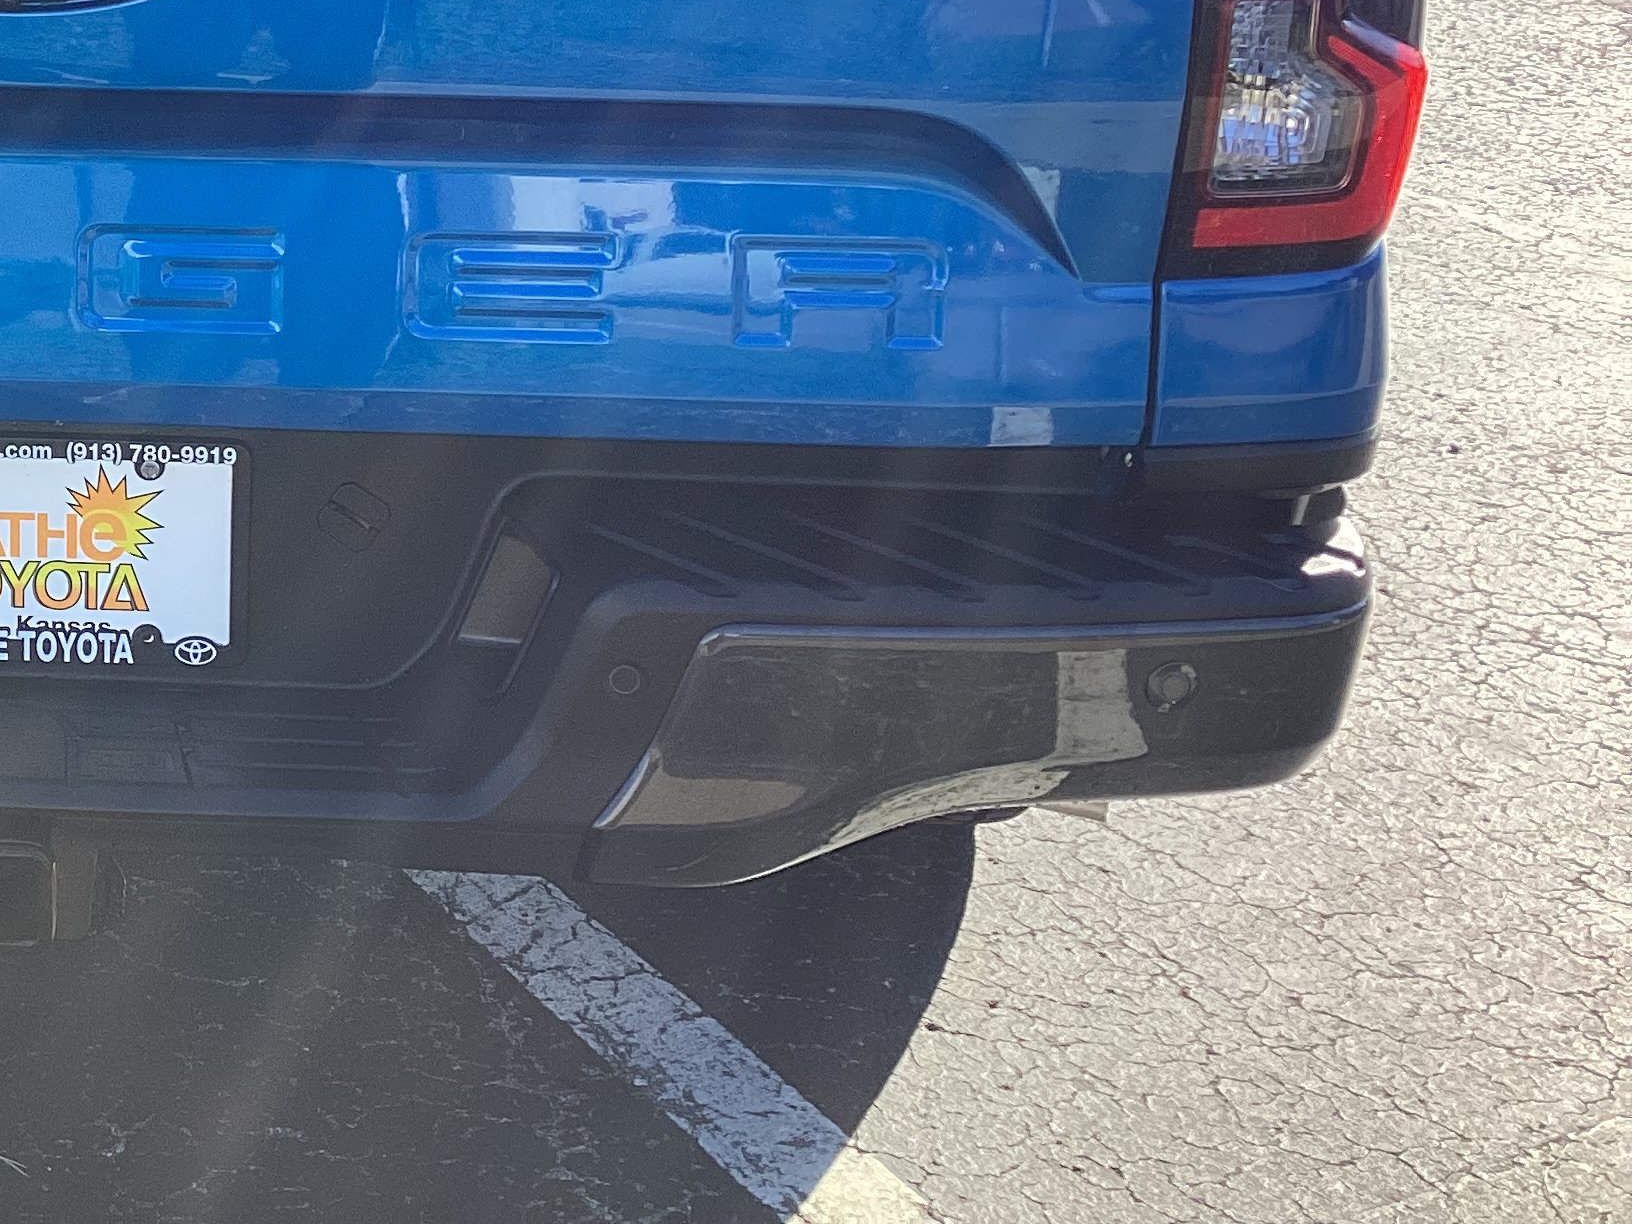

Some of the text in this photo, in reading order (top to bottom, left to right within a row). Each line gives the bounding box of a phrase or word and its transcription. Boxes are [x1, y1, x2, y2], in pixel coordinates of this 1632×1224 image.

[67, 441, 122, 465] (913)
[129, 443, 237, 465] 780-9919
[18, 630, 135, 664] TOYOTA
